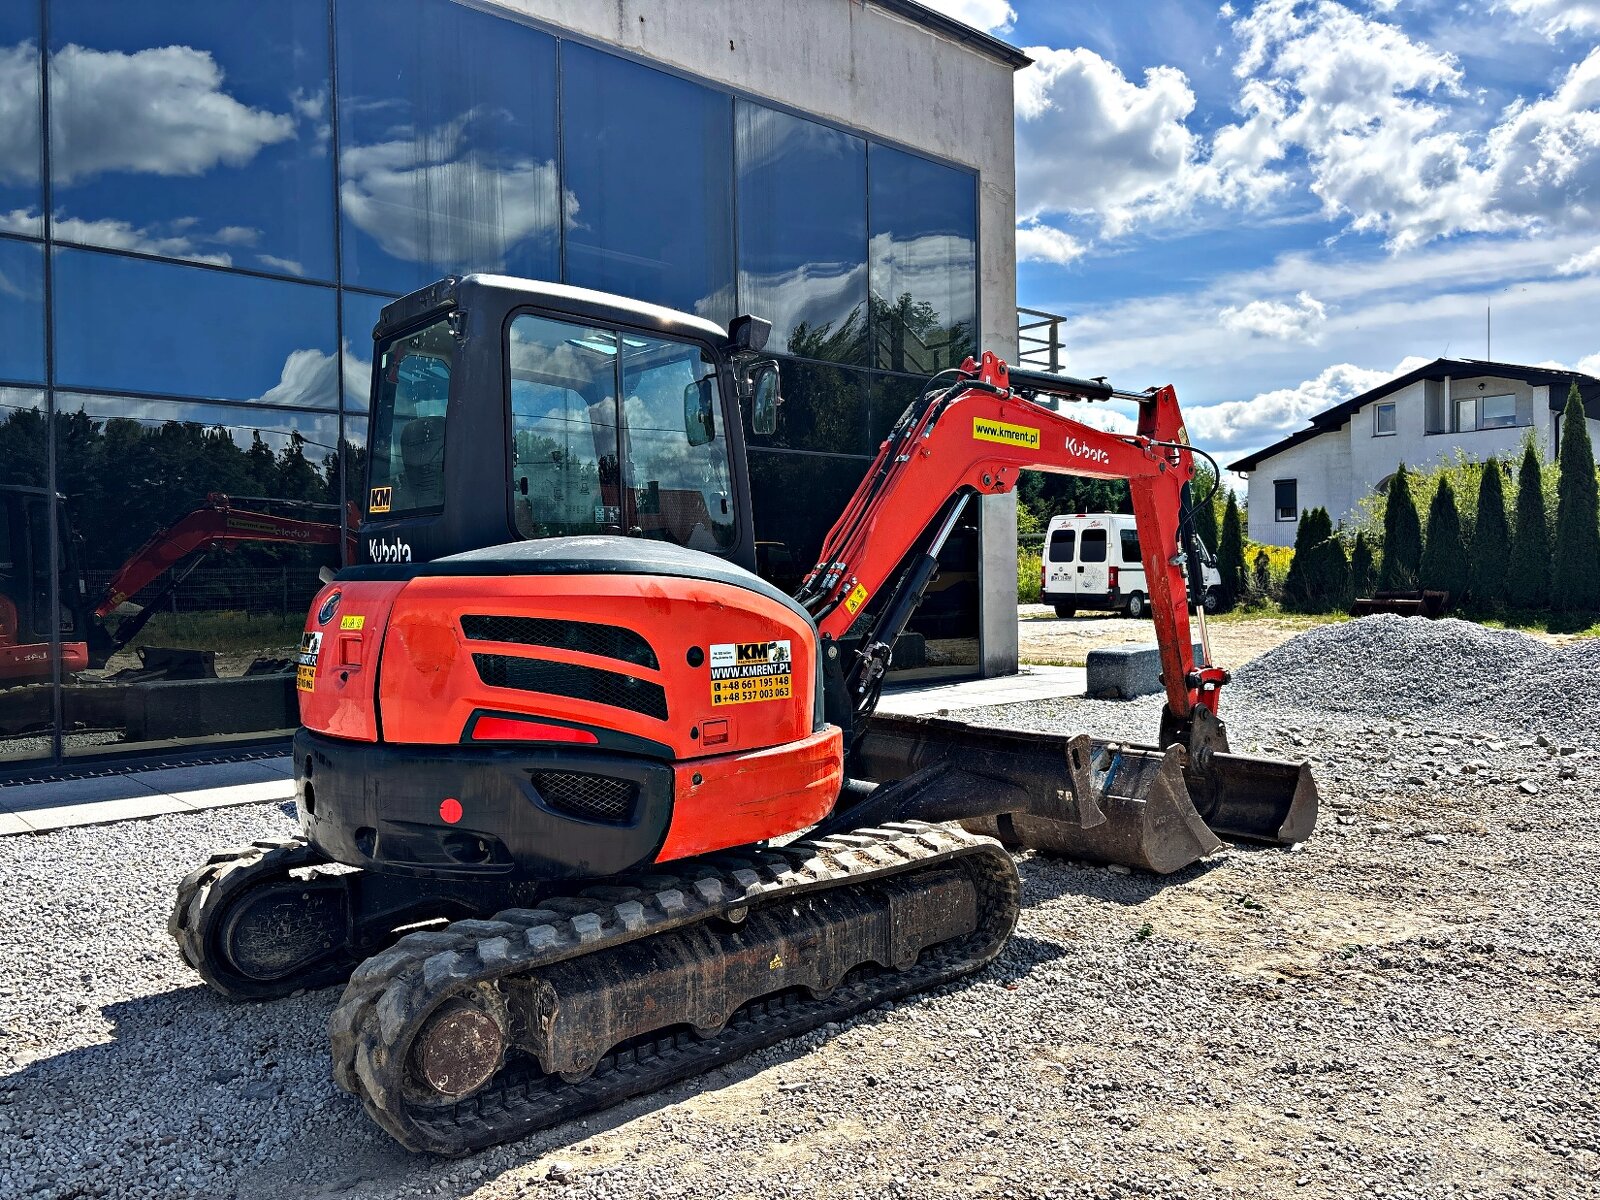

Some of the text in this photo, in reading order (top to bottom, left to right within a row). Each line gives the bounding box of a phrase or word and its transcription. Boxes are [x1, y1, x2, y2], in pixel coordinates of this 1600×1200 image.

[975, 422, 1038, 446] www.kmrent.pl
[1065, 436, 1110, 465] Kubota
[371, 488, 391, 507] KM
[368, 536, 412, 563] Kubota
[736, 643, 768, 660] KM
[711, 662, 791, 680] WWW.KMRENT.PL
[722, 675, 789, 691] +48 661 195 148
[722, 687, 789, 702] +48 537 003 063
